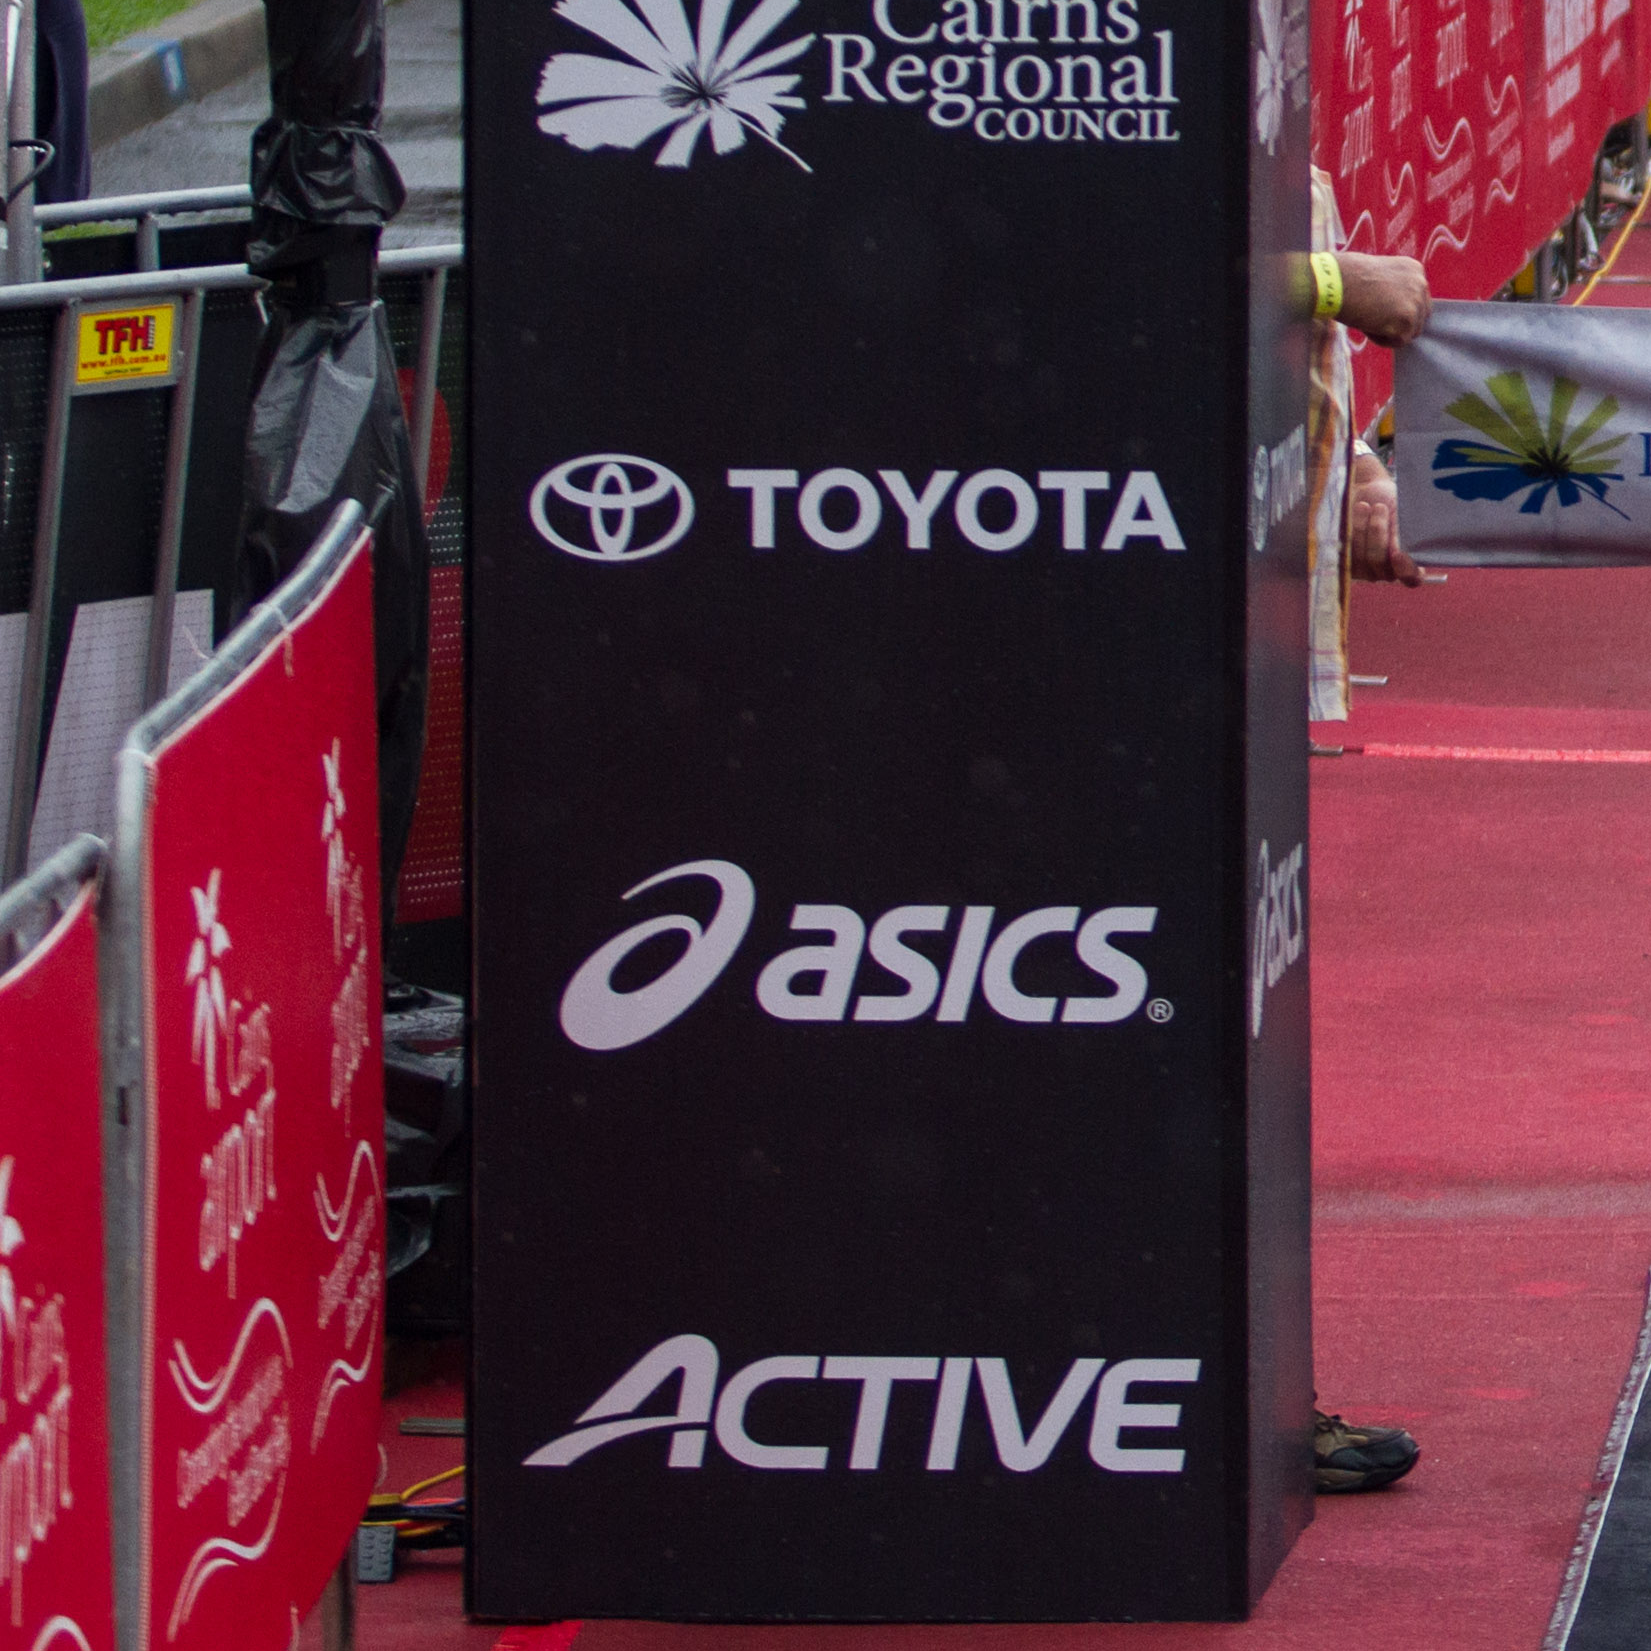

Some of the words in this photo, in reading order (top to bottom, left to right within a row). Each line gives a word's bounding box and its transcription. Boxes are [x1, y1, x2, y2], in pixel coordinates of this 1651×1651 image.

[823, 29, 1179, 129] Regional
[974, 109, 1182, 143] COUNCIL
[95, 315, 150, 355] TFH
[727, 467, 1186, 552] TOYOTA
[757, 903, 1157, 1024] asics
[523, 1334, 1201, 1472] ACTIVE
